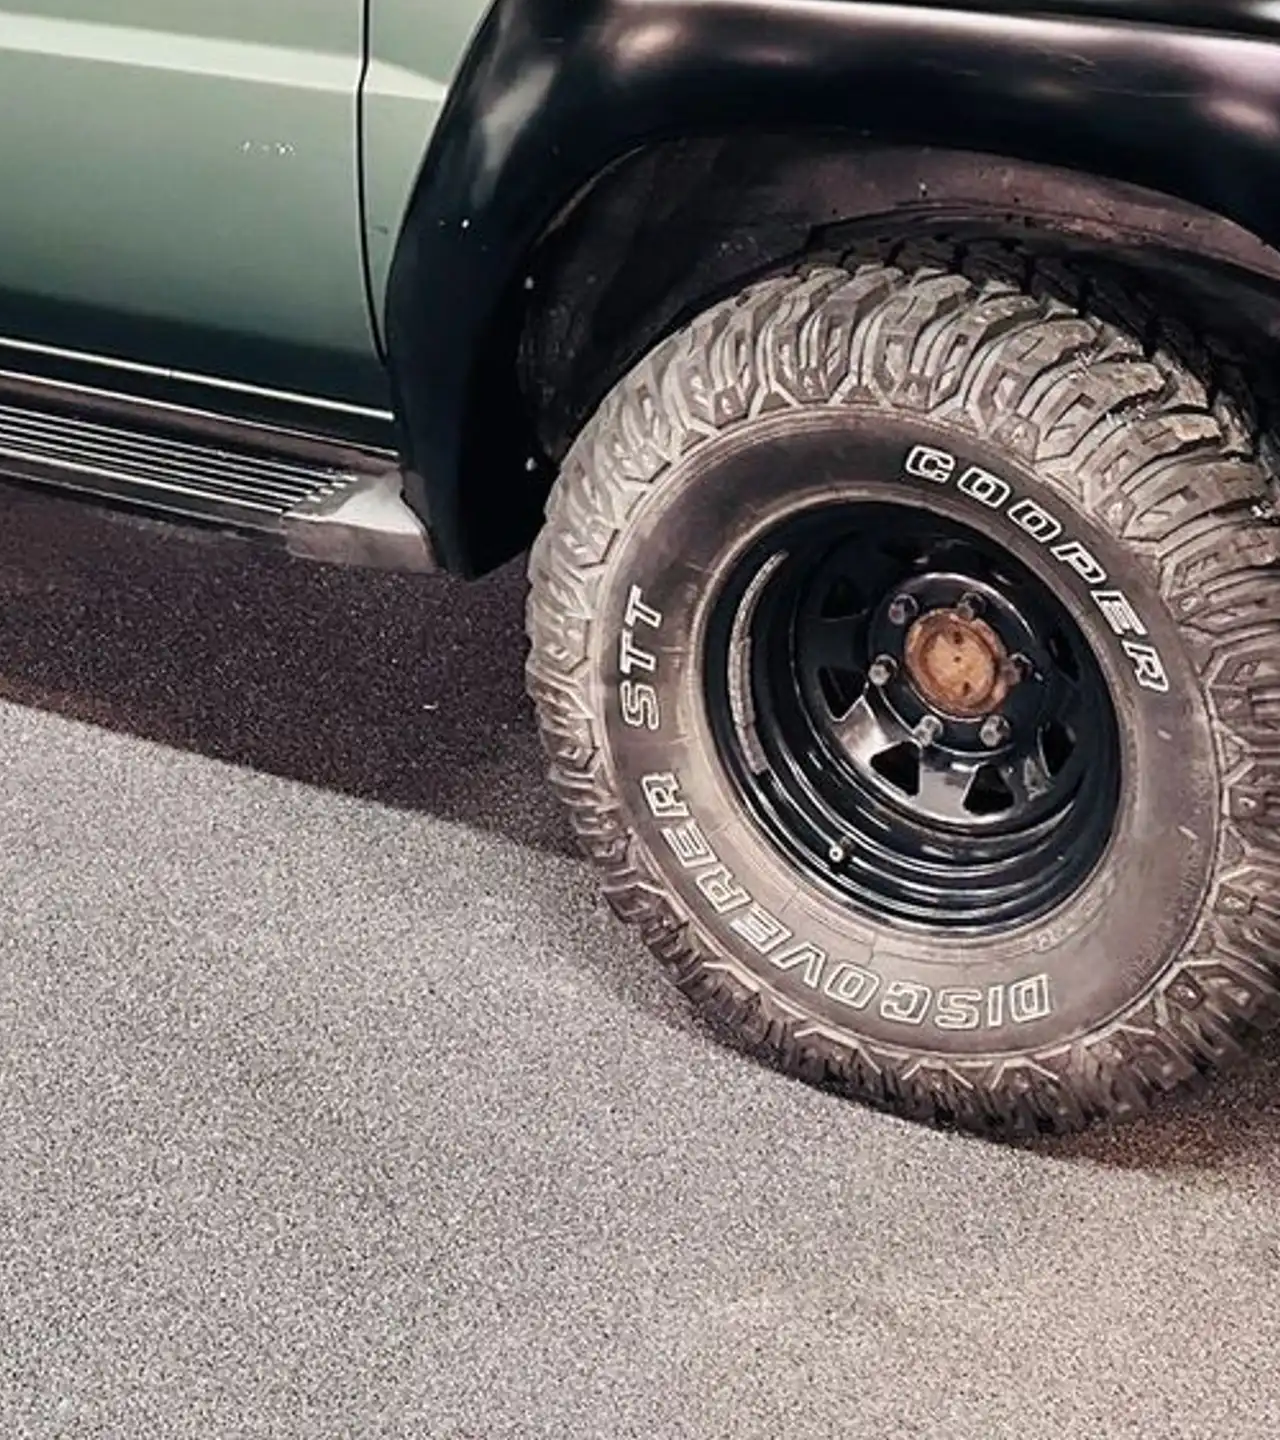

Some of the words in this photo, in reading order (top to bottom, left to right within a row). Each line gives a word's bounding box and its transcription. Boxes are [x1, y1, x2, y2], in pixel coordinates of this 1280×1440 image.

[620, 583, 663, 730] STT
[905, 445, 1169, 692] COOPER
[640, 772, 1052, 1031] DISCOVERER
